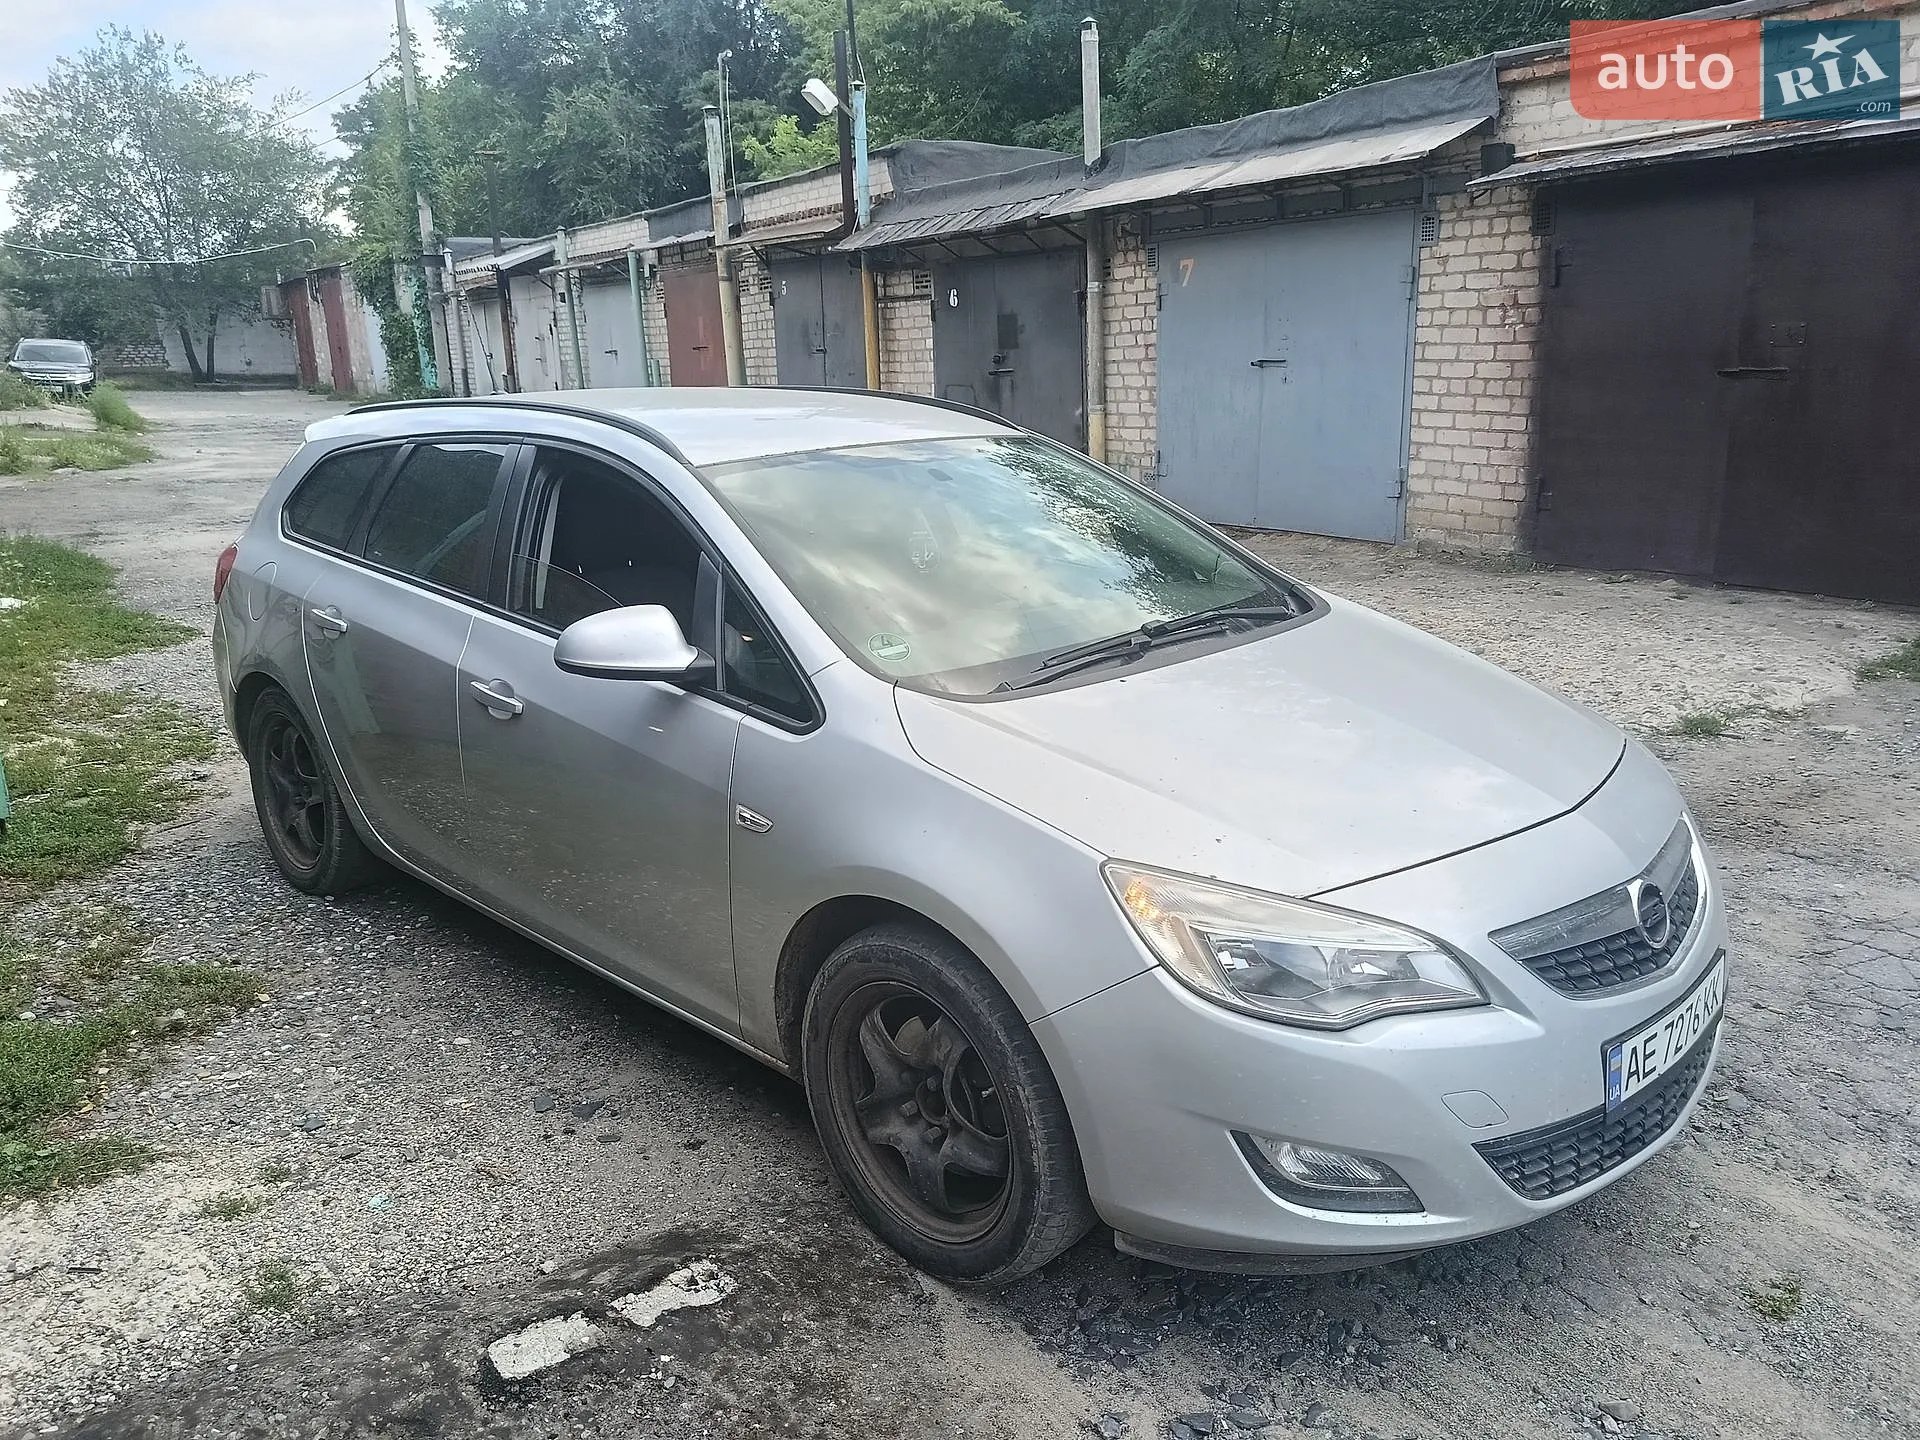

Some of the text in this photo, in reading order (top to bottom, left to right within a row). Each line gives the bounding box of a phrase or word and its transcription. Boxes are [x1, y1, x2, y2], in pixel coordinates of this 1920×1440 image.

[1180, 258, 1194, 288] 7
[781, 280, 787, 296] 5
[949, 288, 958, 307] 6
[1625, 968, 1720, 1092] AE 7276 KK
[1609, 1083, 1621, 1101] UA
